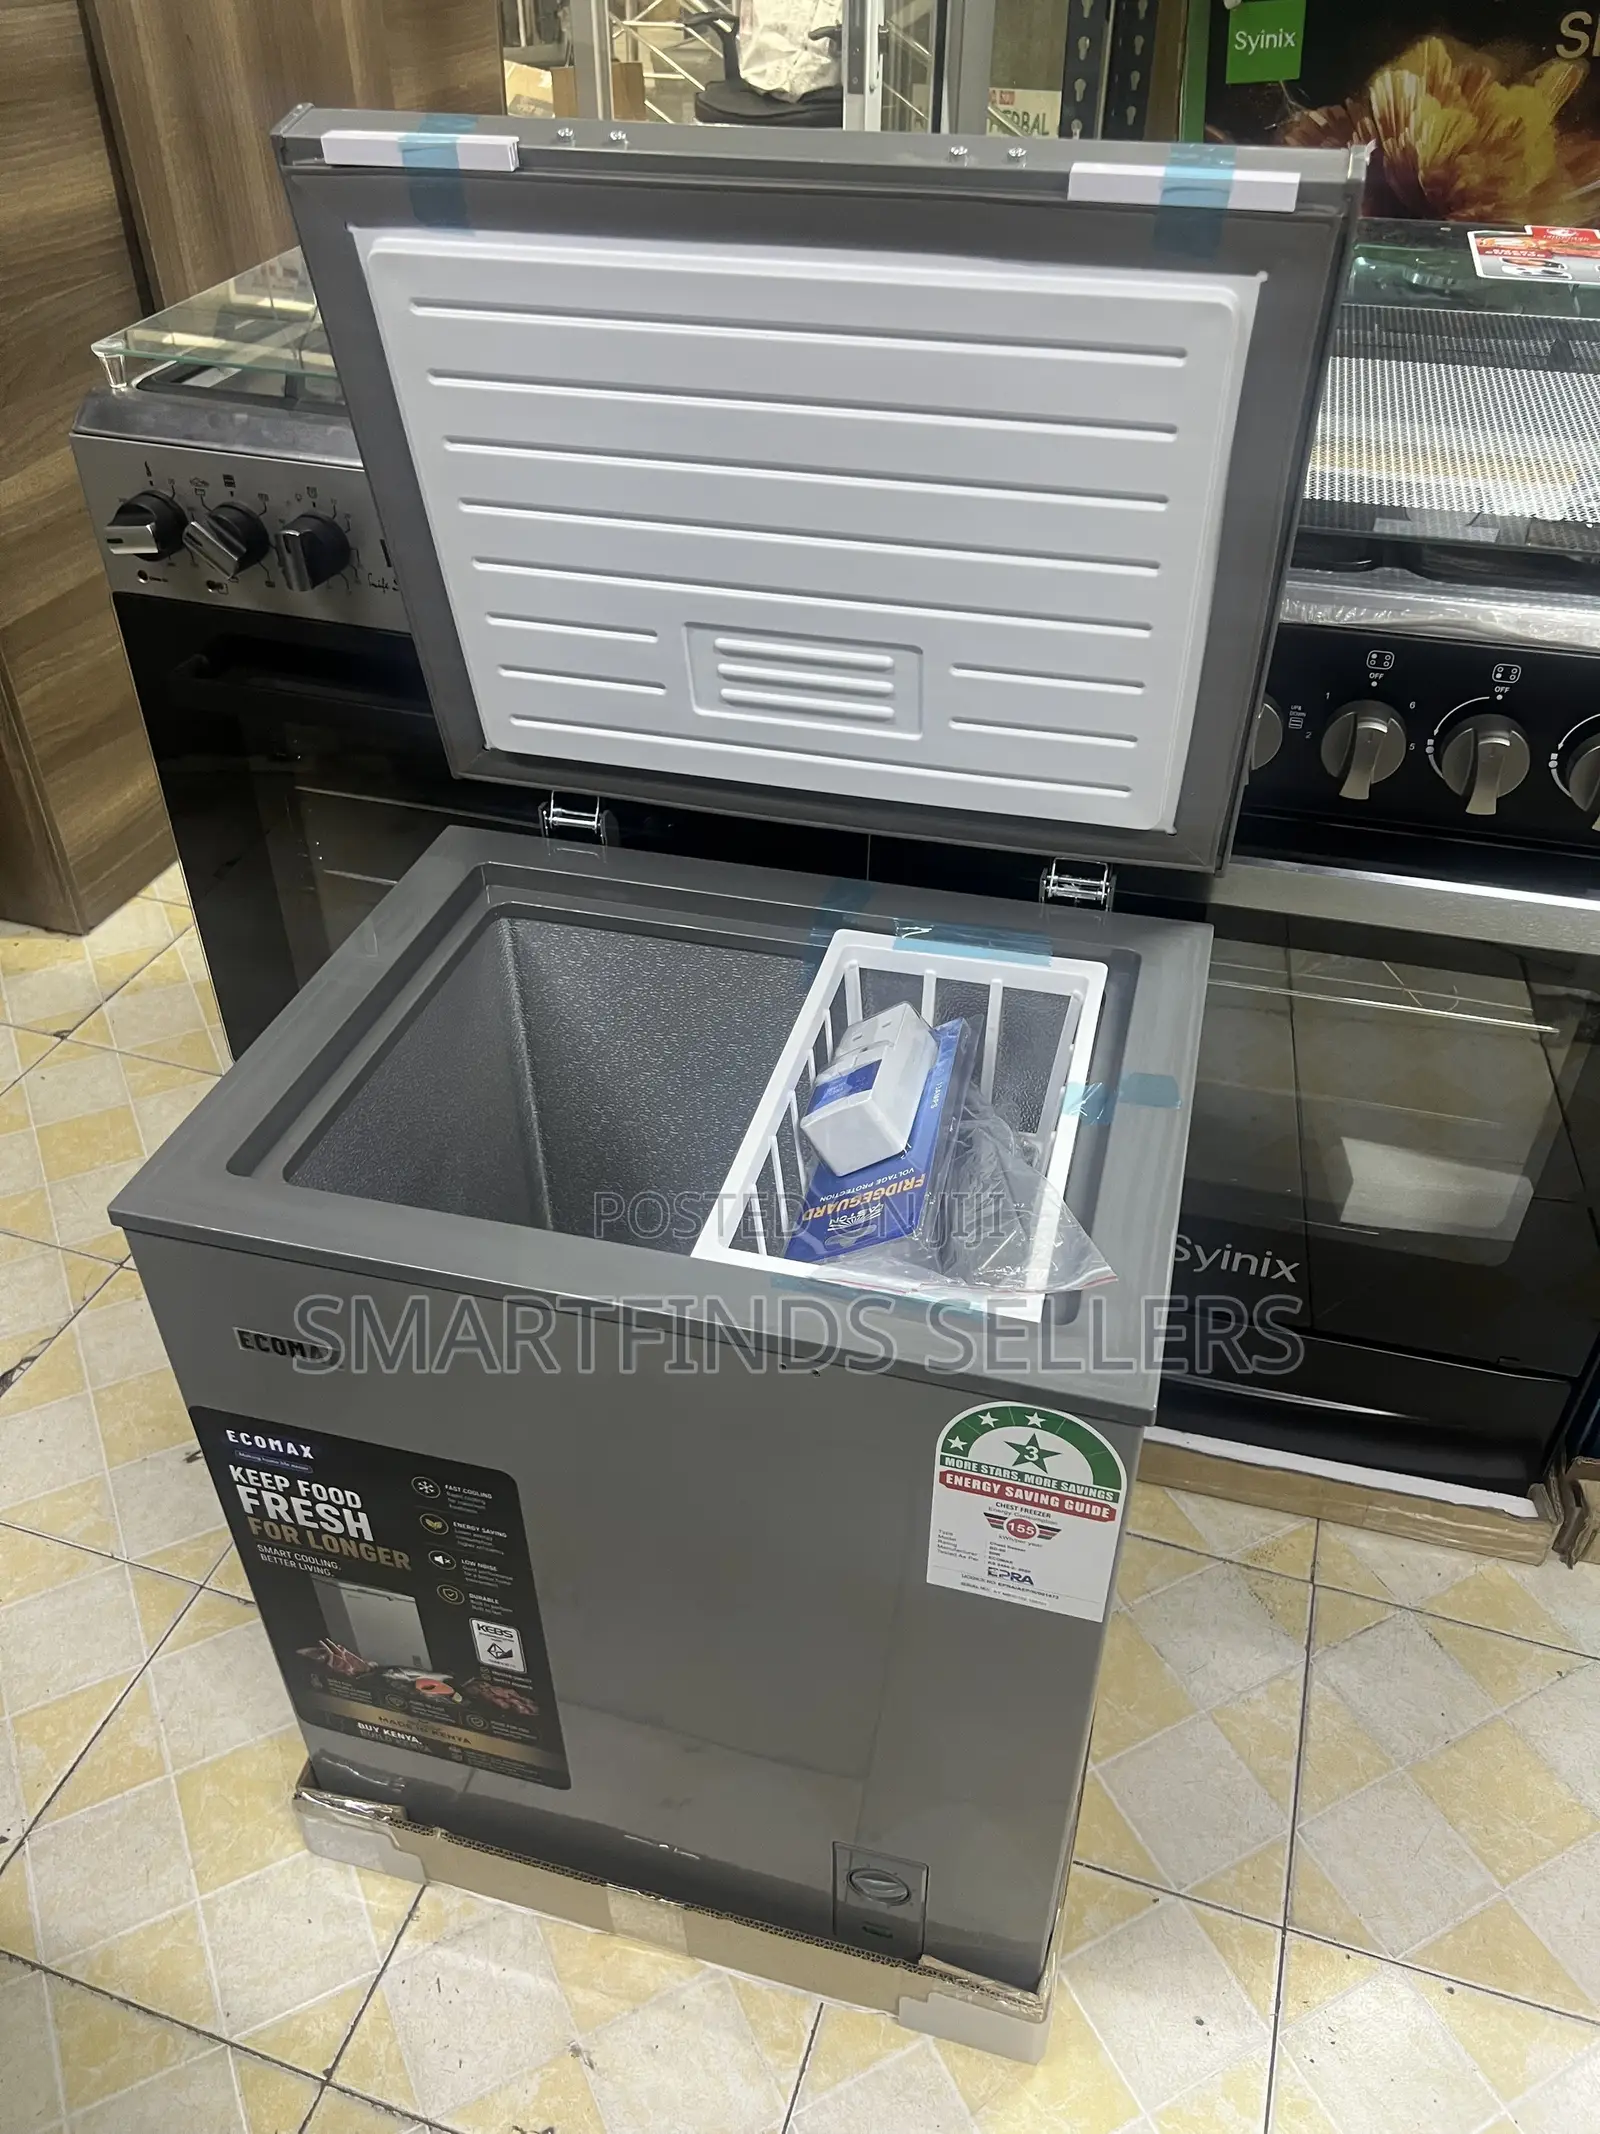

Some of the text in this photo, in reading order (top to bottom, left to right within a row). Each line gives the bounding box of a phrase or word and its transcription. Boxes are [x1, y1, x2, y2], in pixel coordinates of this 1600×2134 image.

[1234, 28, 1296, 55] Syinix
[1369, 672, 1384, 680] OFF
[1409, 743, 1415, 751] 5
[819, 1167, 915, 1202] VOLTAGE PROTECTION
[802, 1173, 926, 1221] FRIDGEGUARD
[1174, 1233, 1300, 1284] Syinix
[226, 1429, 314, 1459] ECOMAX
[1024, 1446, 1038, 1461] 3
[229, 1464, 361, 1509] KEEP FOOD
[944, 1457, 978, 1472] MORE
[1024, 1474, 1058, 1489] MORE
[1060, 1481, 1114, 1501] SAVINGS
[445, 1484, 493, 1499] FAST COOLING
[946, 1473, 1111, 1519] ENERGY SAVING GUIDE
[236, 1484, 374, 1542] FRESH
[988, 1506, 1012, 1517] Energy
[995, 1501, 1051, 1519] CHEST FREEZER
[453, 1522, 507, 1538] ENERGY SAVING
[1007, 1522, 1035, 1536] 155
[247, 1515, 412, 1571] FOR LONGER
[257, 1544, 292, 1558] SMART
[260, 1554, 297, 1568] BETTER
[461, 1559, 498, 1571] LOW NOISE
[987, 1566, 1034, 1586] EPRA
[469, 1593, 499, 1604] DURABLE
[476, 1623, 514, 1639] KEBS
[357, 1721, 380, 1733] BUY
